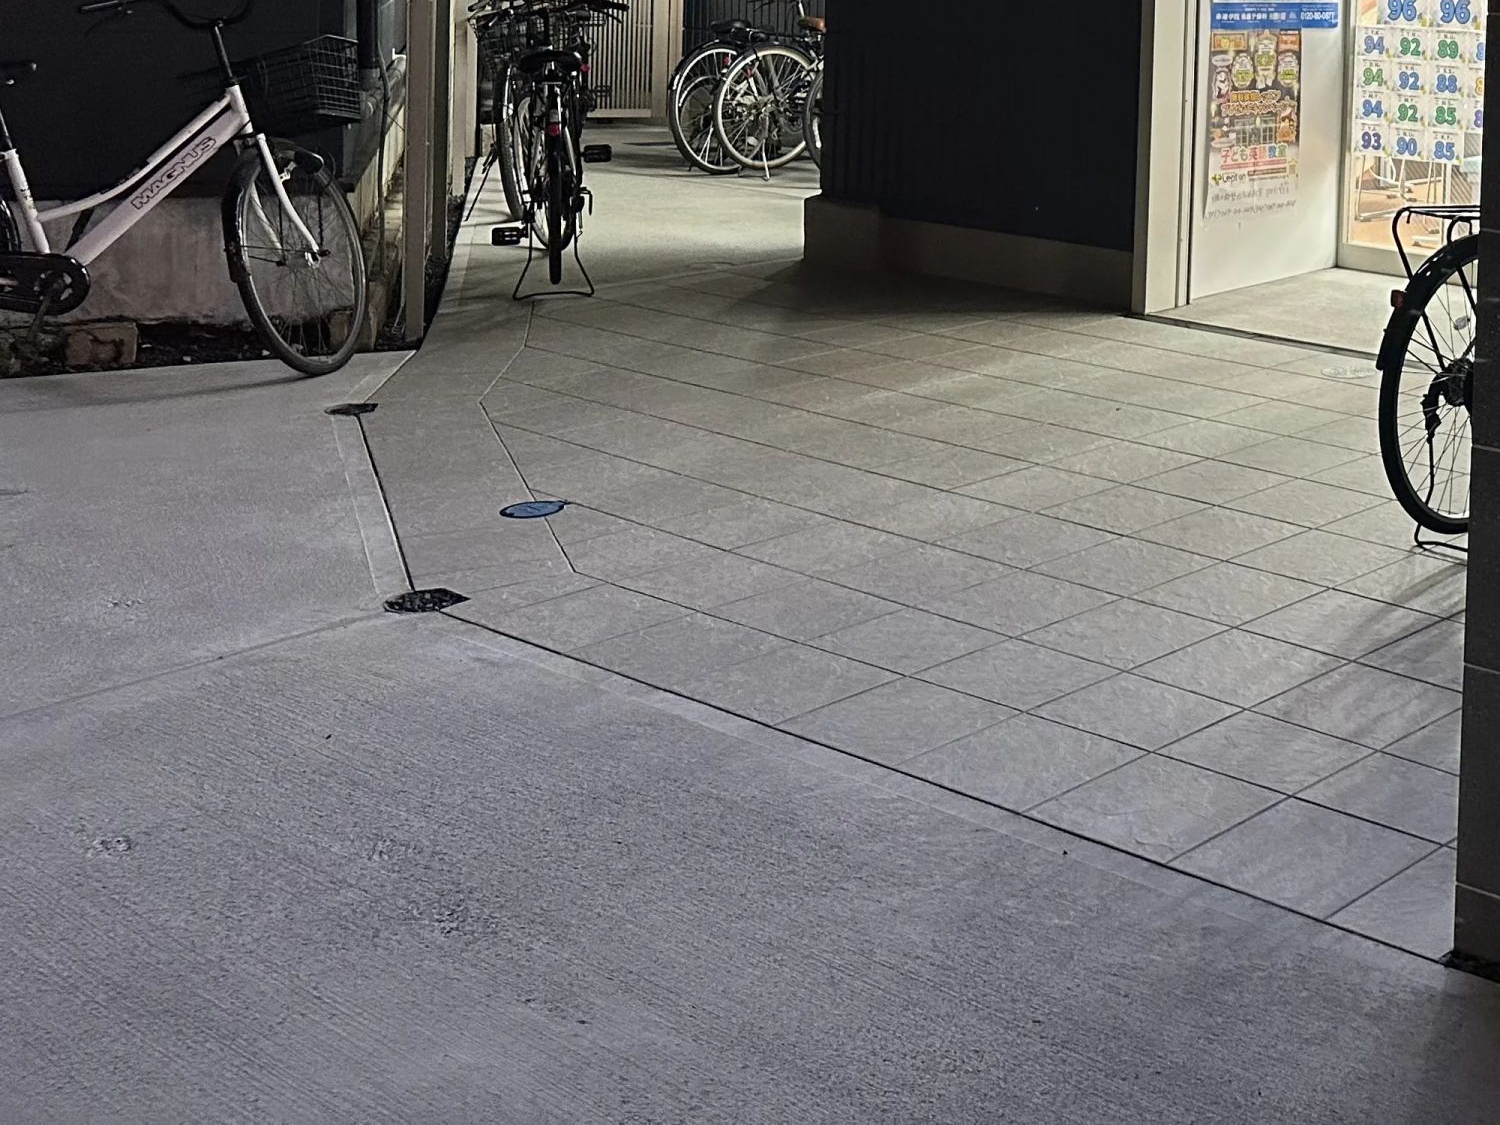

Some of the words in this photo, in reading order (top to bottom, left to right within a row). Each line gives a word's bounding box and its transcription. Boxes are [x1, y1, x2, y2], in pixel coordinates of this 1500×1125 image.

[1364, 35, 1385, 55] 94
[1400, 37, 1421, 56] 92
[1437, 39, 1458, 59] 89
[1363, 67, 1384, 87] 94
[1399, 71, 1420, 91] 92
[1436, 73, 1458, 93] 88
[1362, 99, 1383, 118] 94
[1398, 103, 1418, 123] 92
[1435, 105, 1456, 125] 85
[1362, 131, 1382, 151] 93
[1396, 137, 1418, 156] 90
[1434, 141, 1456, 161] 85
[130, 136, 217, 210] MAGNUS
